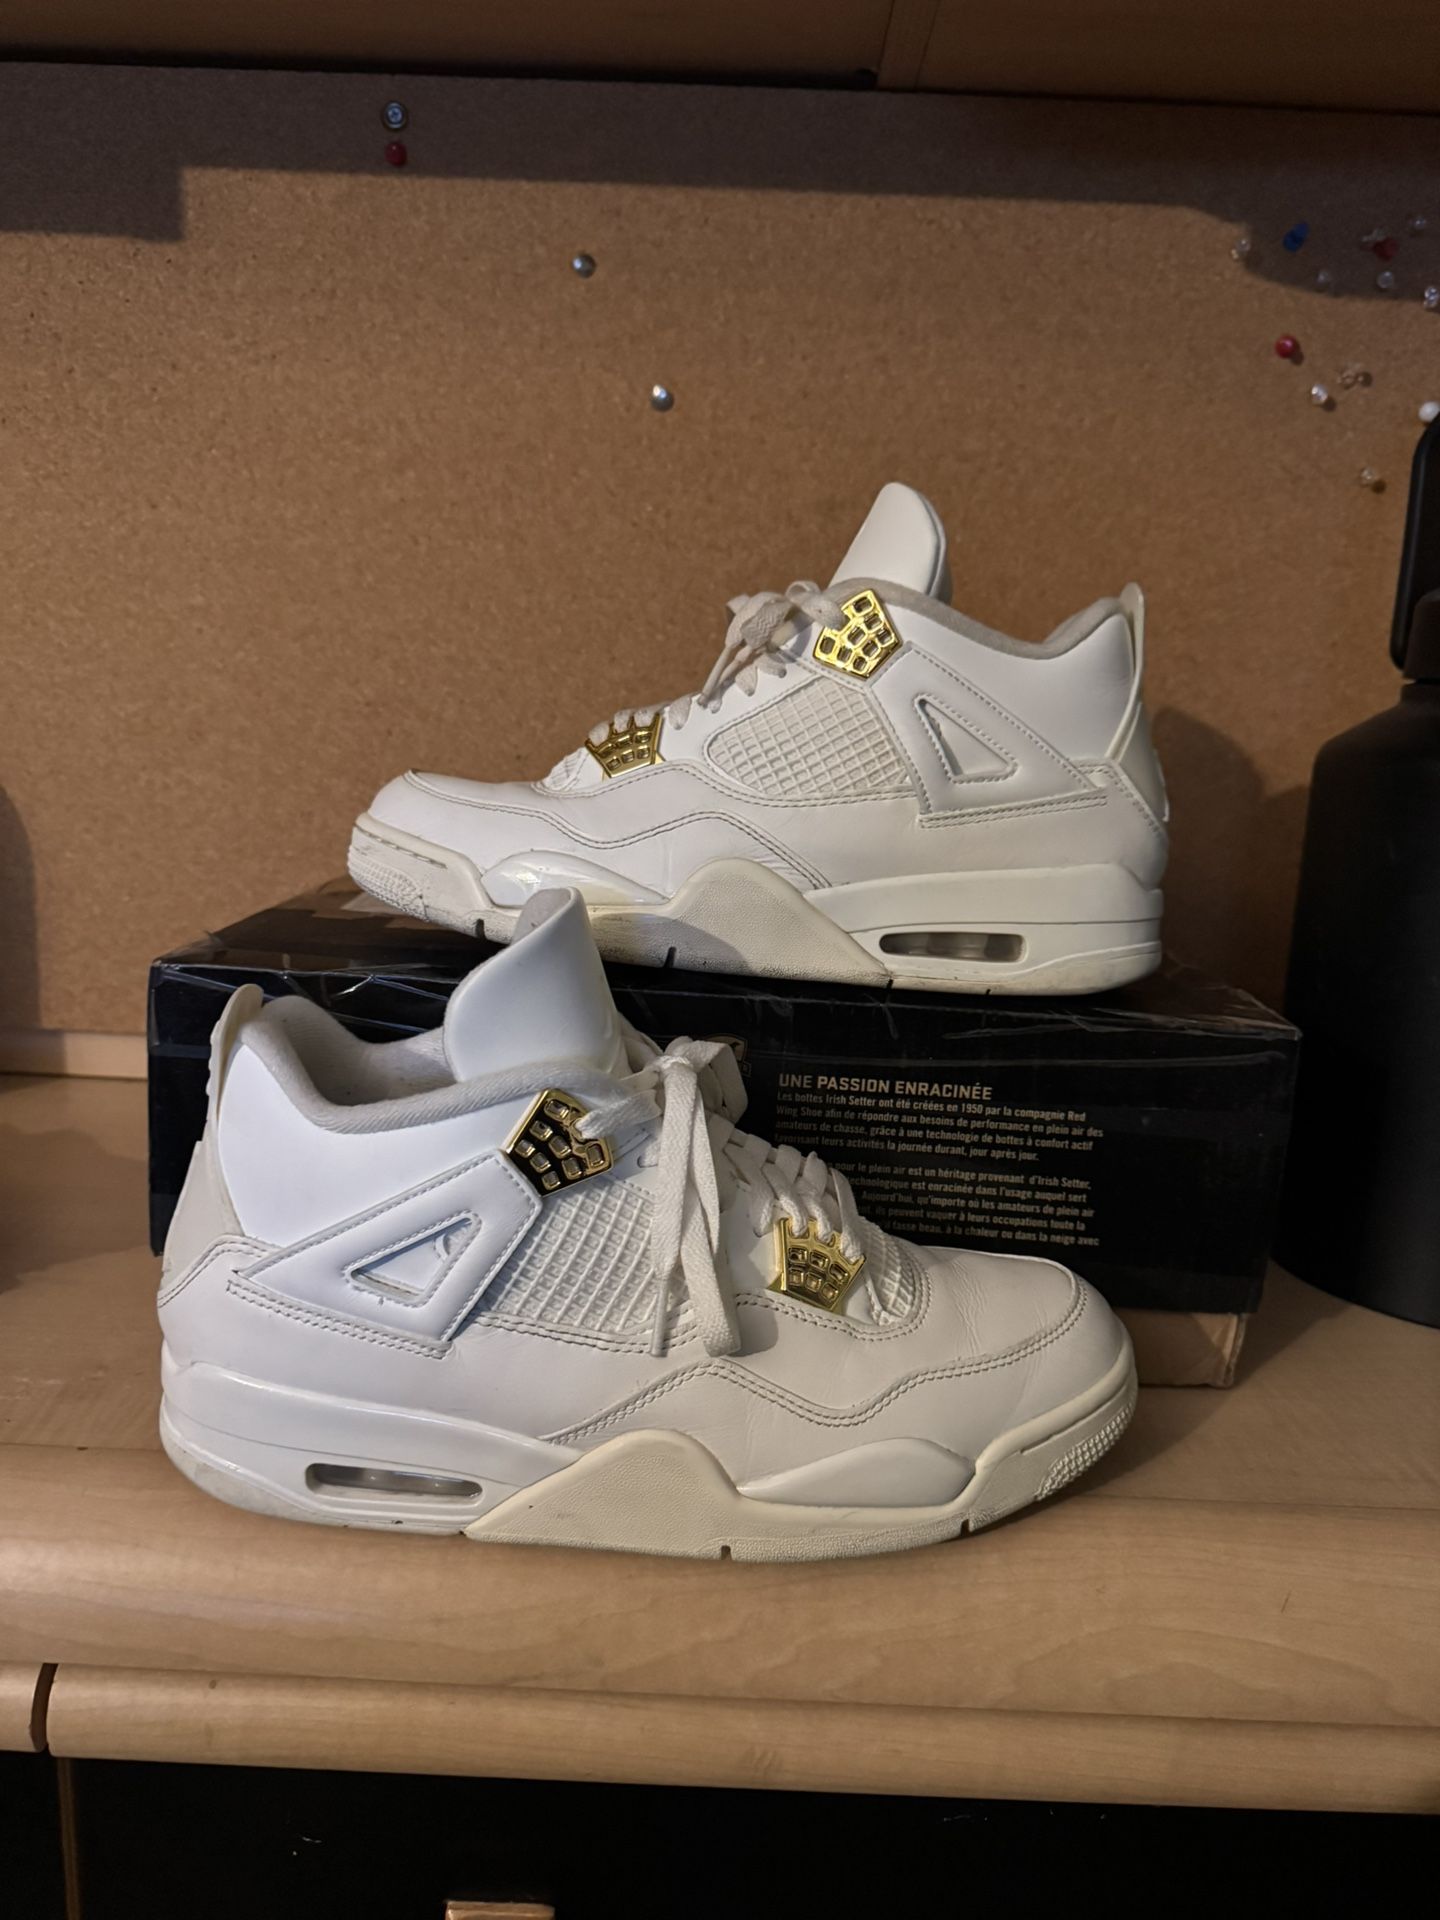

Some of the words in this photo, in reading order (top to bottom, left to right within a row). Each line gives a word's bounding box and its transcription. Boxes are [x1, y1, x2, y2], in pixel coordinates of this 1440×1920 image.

[778, 1073, 813, 1088] UNE
[817, 1075, 890, 1093] PASSION
[894, 1080, 993, 1100] ENRACINÉE
[776, 1089, 792, 1101] Les
[794, 1092, 823, 1104] bottes
[826, 1094, 846, 1105] Irish
[848, 1095, 876, 1106] Setter
[878, 1098, 894, 1108] ont
[896, 1098, 911, 1109] été
[912, 1100, 944, 1112] créées
[946, 1103, 958, 1112] en
[961, 1102, 984, 1114] 1950
[985, 1106, 1002, 1116] par
[1002, 1105, 1012, 1116] la
[1014, 1109, 1066, 1121] compagnie
[1067, 1110, 1086, 1122] Red
[776, 1104, 798, 1118] Wing
[800, 1106, 823, 1117] Shoe
[825, 1108, 842, 1118] afin
[844, 1109, 856, 1120] de
[858, 1110, 900, 1122] répondre
[900, 1114, 918, 1124] aux
[919, 1114, 955, 1126] besoins
[956, 1117, 968, 1128] de
[970, 1118, 1030, 1132] performance
[1032, 1124, 1044, 1133] en
[1046, 1123, 1070, 1135] plein
[1070, 1126, 1085, 1136] air
[1086, 1126, 1104, 1138] des
[774, 1133, 820, 1144] favorisant
[821, 1136, 844, 1146] leurs
[846, 1138, 885, 1150] activités
[886, 1140, 896, 1150] la
[897, 1140, 933, 1152] journée
[934, 1144, 968, 1156] durant,
[969, 1146, 990, 1158] jour
[990, 1148, 1017, 1160] après
[1018, 1148, 1041, 1162] jour.
[776, 1120, 818, 1131] amateurs
[819, 1122, 832, 1132] de
[870, 1124, 896, 1136] grâce
[898, 1126, 904, 1137] à
[906, 1129, 924, 1138] une
[926, 1129, 980, 1144] technologie
[981, 1133, 994, 1144] de
[995, 1133, 1025, 1146] bottes
[1026, 1136, 1033, 1146] à
[1034, 1138, 1070, 1150] confort
[1070, 1140, 1094, 1151] actif
[858, 1162, 867, 1173] le
[868, 1163, 892, 1174] plein
[892, 1164, 906, 1175] air
[908, 1166, 922, 1176] est
[924, 1168, 936, 1176] un
[938, 1168, 976, 1182] héritage
[978, 1172, 1025, 1184] provenant
[1028, 1174, 1060, 1186] d'Irish
[911, 1181, 926, 1190] est
[928, 1182, 974, 1194] enracinée
[976, 1184, 998, 1196] dans
[1000, 1186, 1032, 1200] l'usage
[1034, 1190, 1066, 1202] auquel
[1068, 1193, 1087, 1204] sert
[917, 1194, 966, 1208] qu'importe
[968, 1198, 980, 1208] où
[981, 1198, 995, 1210] les
[996, 1201, 1040, 1214] amateurs
[1042, 1204, 1055, 1214] de
[1056, 1205, 1080, 1216] plein
[1081, 1207, 1096, 1218] air
[888, 1208, 924, 1218] peuvent
[926, 1210, 958, 1222] vaquer
[958, 1210, 966, 1222] à
[967, 1212, 990, 1223] leurs
[992, 1216, 1048, 1228] occupations
[1050, 1218, 1075, 1230] toute
[1076, 1220, 1086, 1232] la
[946, 1224, 952, 1234] à
[953, 1224, 963, 1235] la
[964, 1226, 1000, 1238] chaleur
[1001, 1229, 1014, 1240] ou
[1014, 1230, 1037, 1242] dans
[1038, 1231, 1048, 1242] la
[1049, 1233, 1076, 1246] neige
[1077, 1236, 1100, 1246] avec
